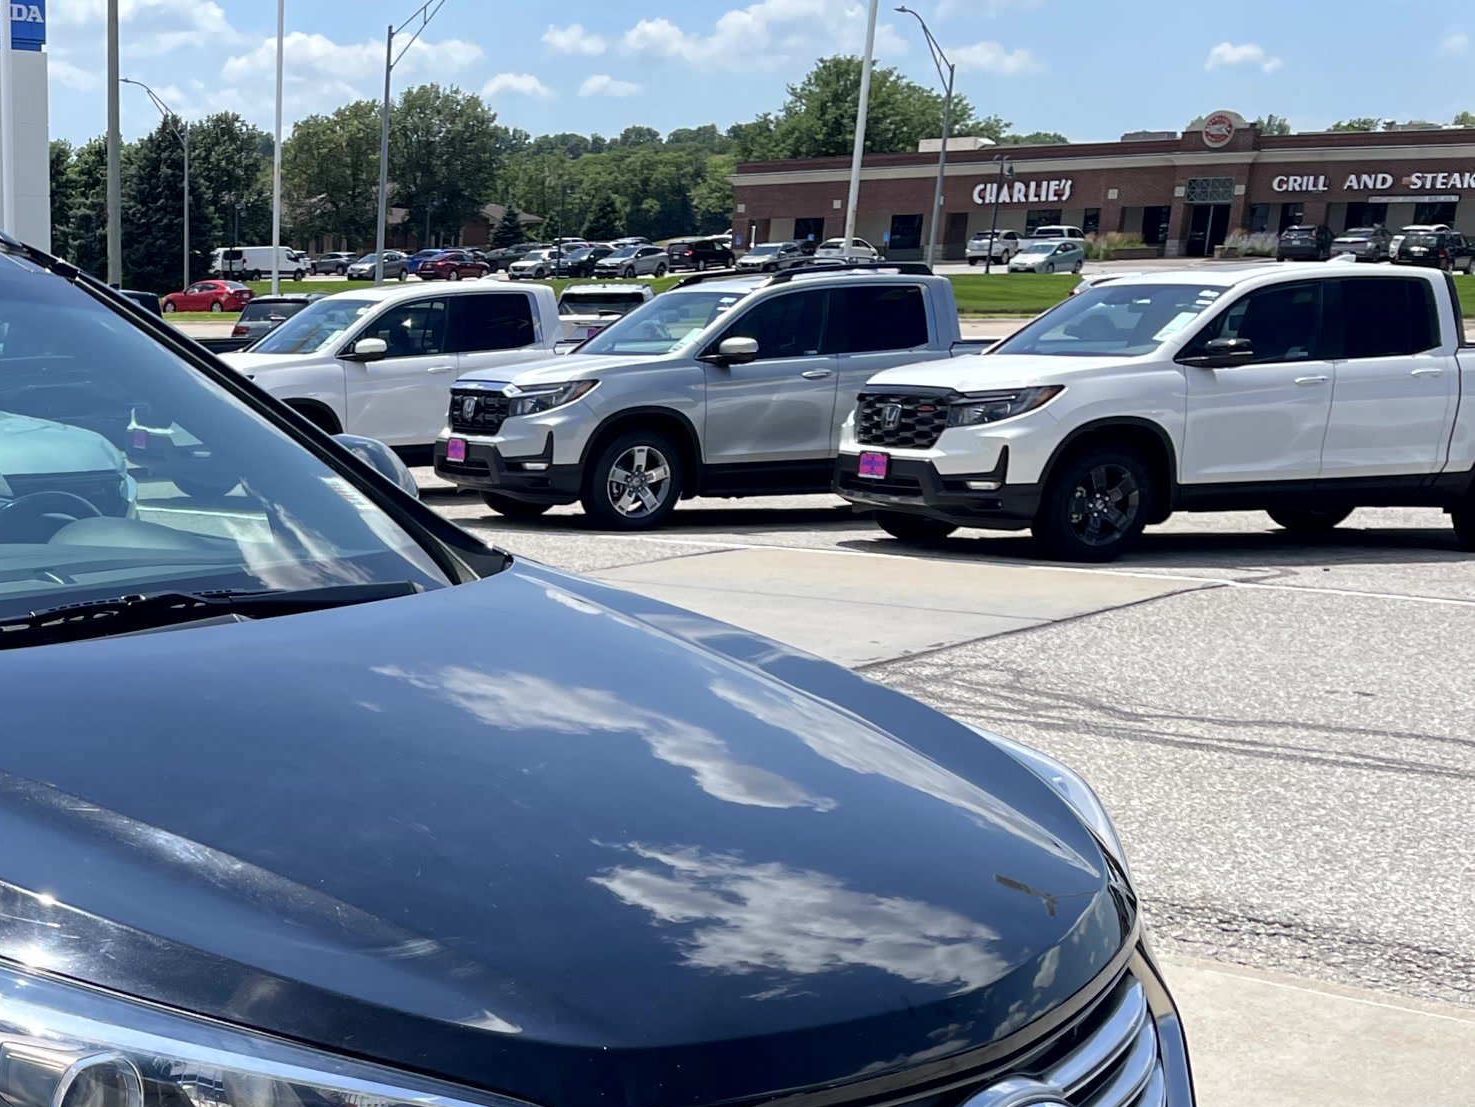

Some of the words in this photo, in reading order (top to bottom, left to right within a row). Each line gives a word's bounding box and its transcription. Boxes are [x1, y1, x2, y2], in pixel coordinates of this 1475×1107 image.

[972, 179, 1072, 204] CHARLIE'S
[1272, 175, 1329, 192] GRILL
[1343, 173, 1393, 190] AND
